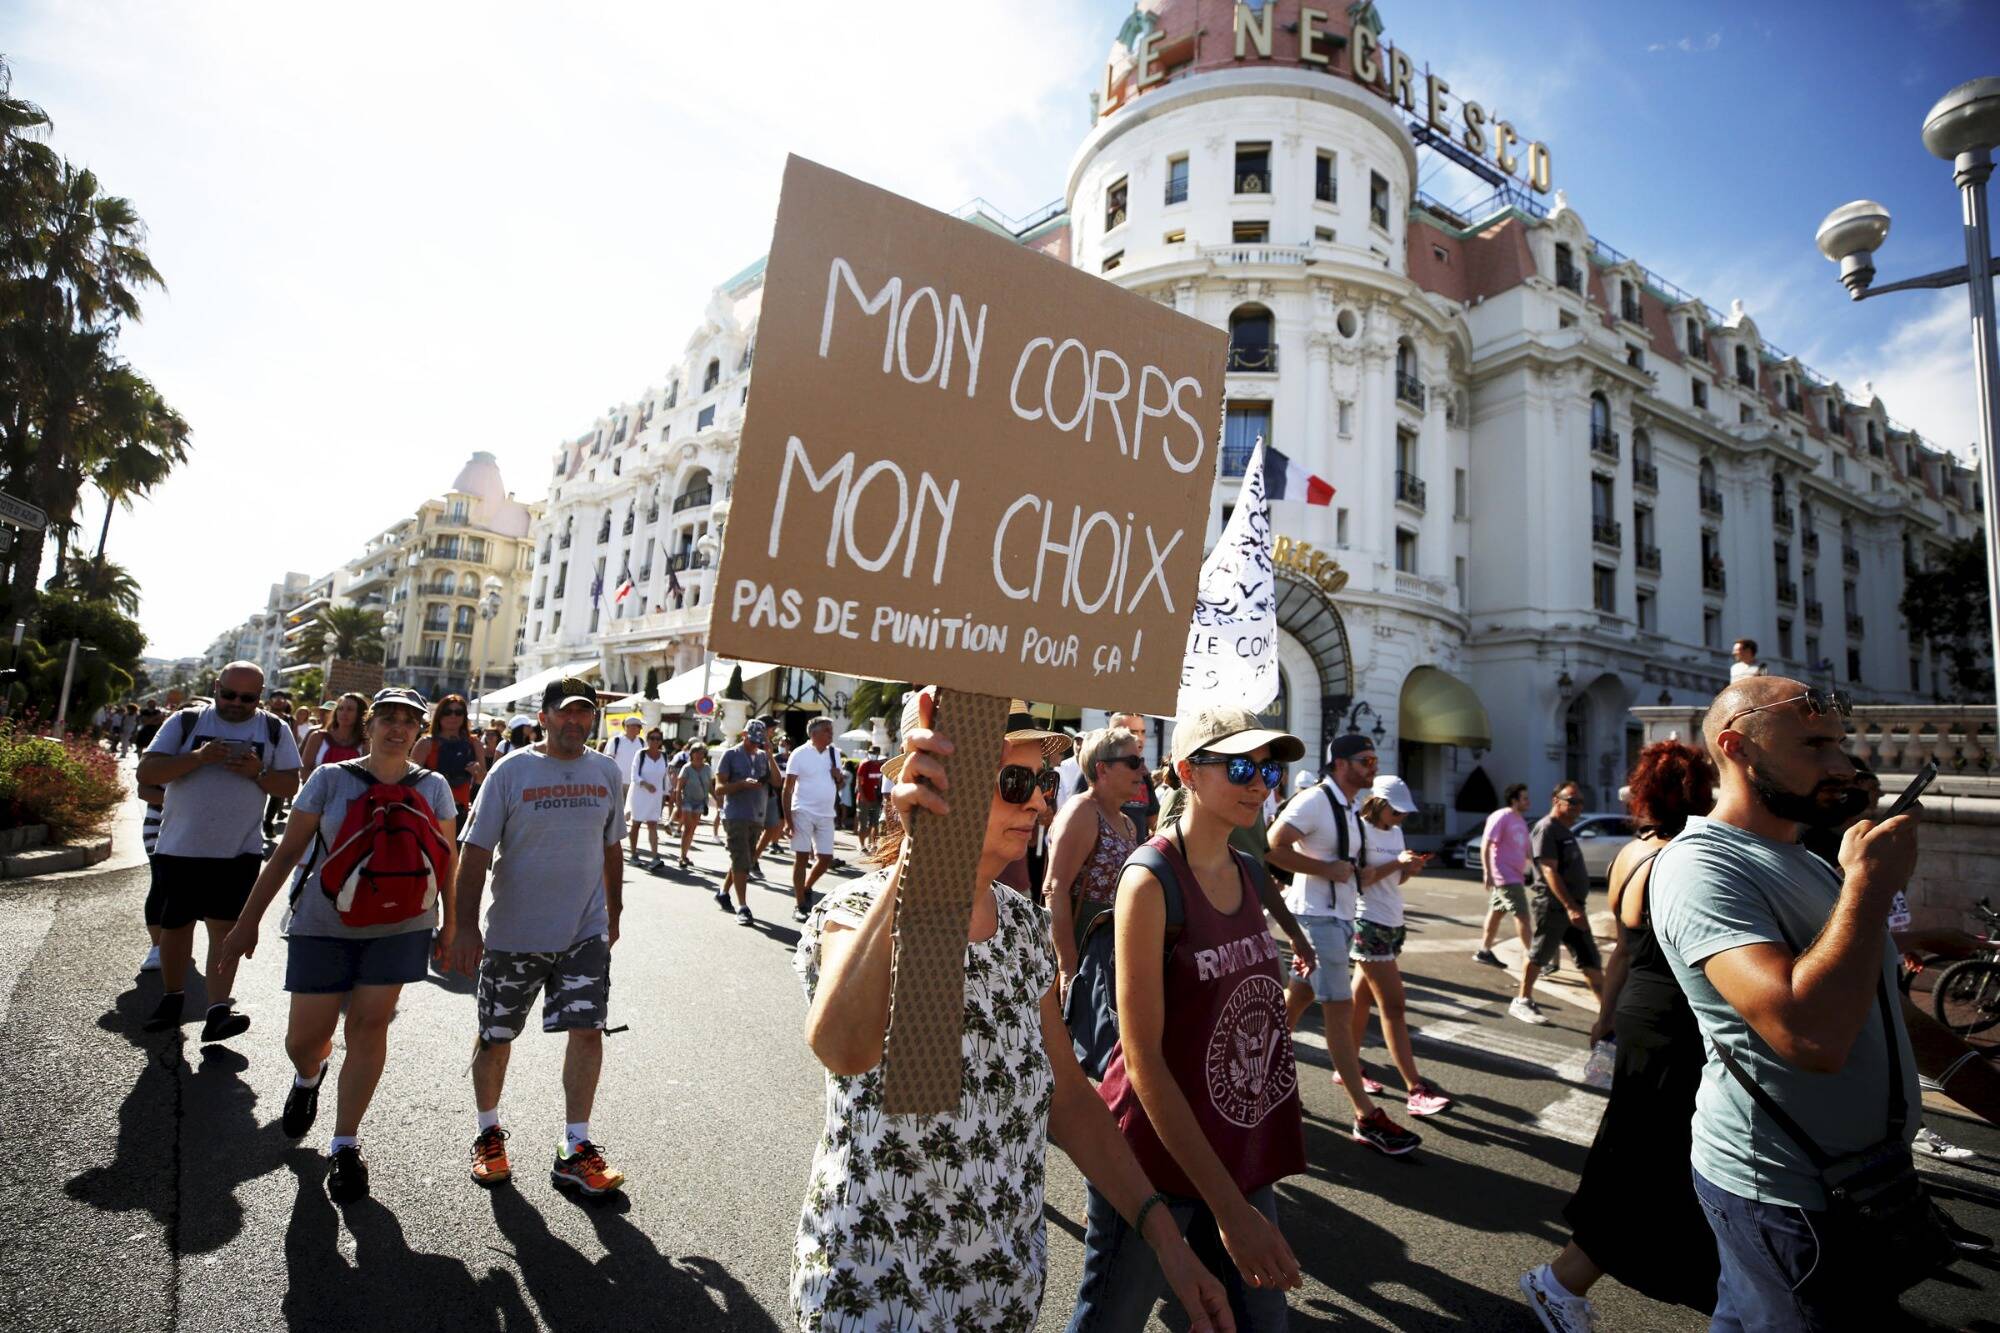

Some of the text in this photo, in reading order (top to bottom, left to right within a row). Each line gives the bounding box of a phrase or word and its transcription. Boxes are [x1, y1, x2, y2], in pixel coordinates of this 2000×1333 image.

[1101, 1, 1552, 195] LE NEGRESCO
[818, 257, 1204, 473] MON CORPS
[768, 435, 960, 586] MON
[731, 579, 803, 629] PAS
[814, 596, 861, 639] DE
[1020, 626, 1079, 667] POUR
[522, 784, 608, 801] BROWNS
[534, 798, 601, 811] FOOTBALL
[1228, 979, 1281, 1017] JOHNNY
[1209, 1023, 1234, 1112] TOMMY
